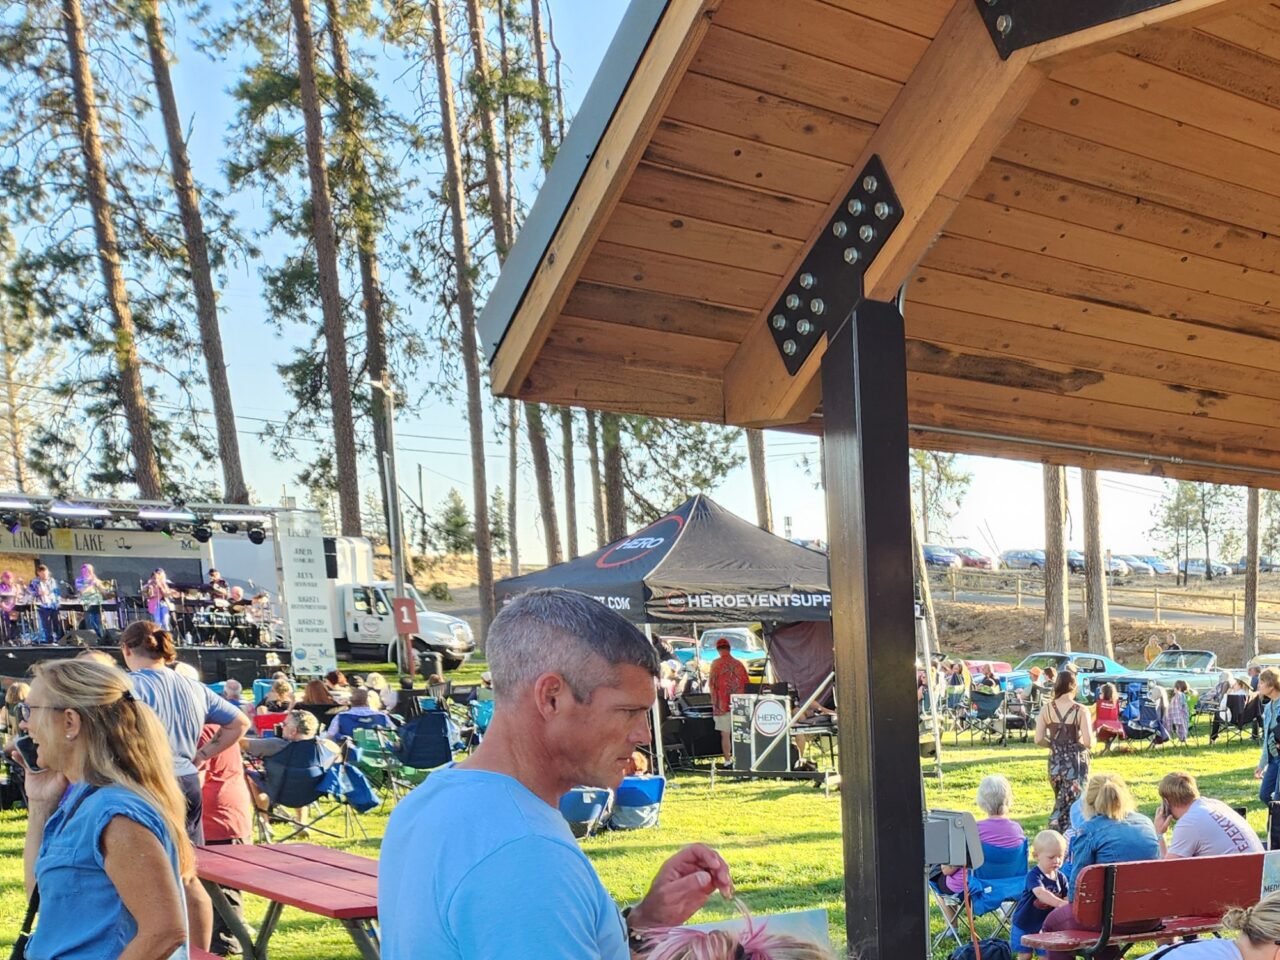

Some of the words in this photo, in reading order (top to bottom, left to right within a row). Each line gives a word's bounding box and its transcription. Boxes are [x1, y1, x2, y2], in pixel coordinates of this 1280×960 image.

[74, 533, 105, 551] LAKE
[616, 537, 664, 550] HERO
[688, 594, 831, 608] HEROEVENTSUPP
[400, 606, 412, 623] 1
